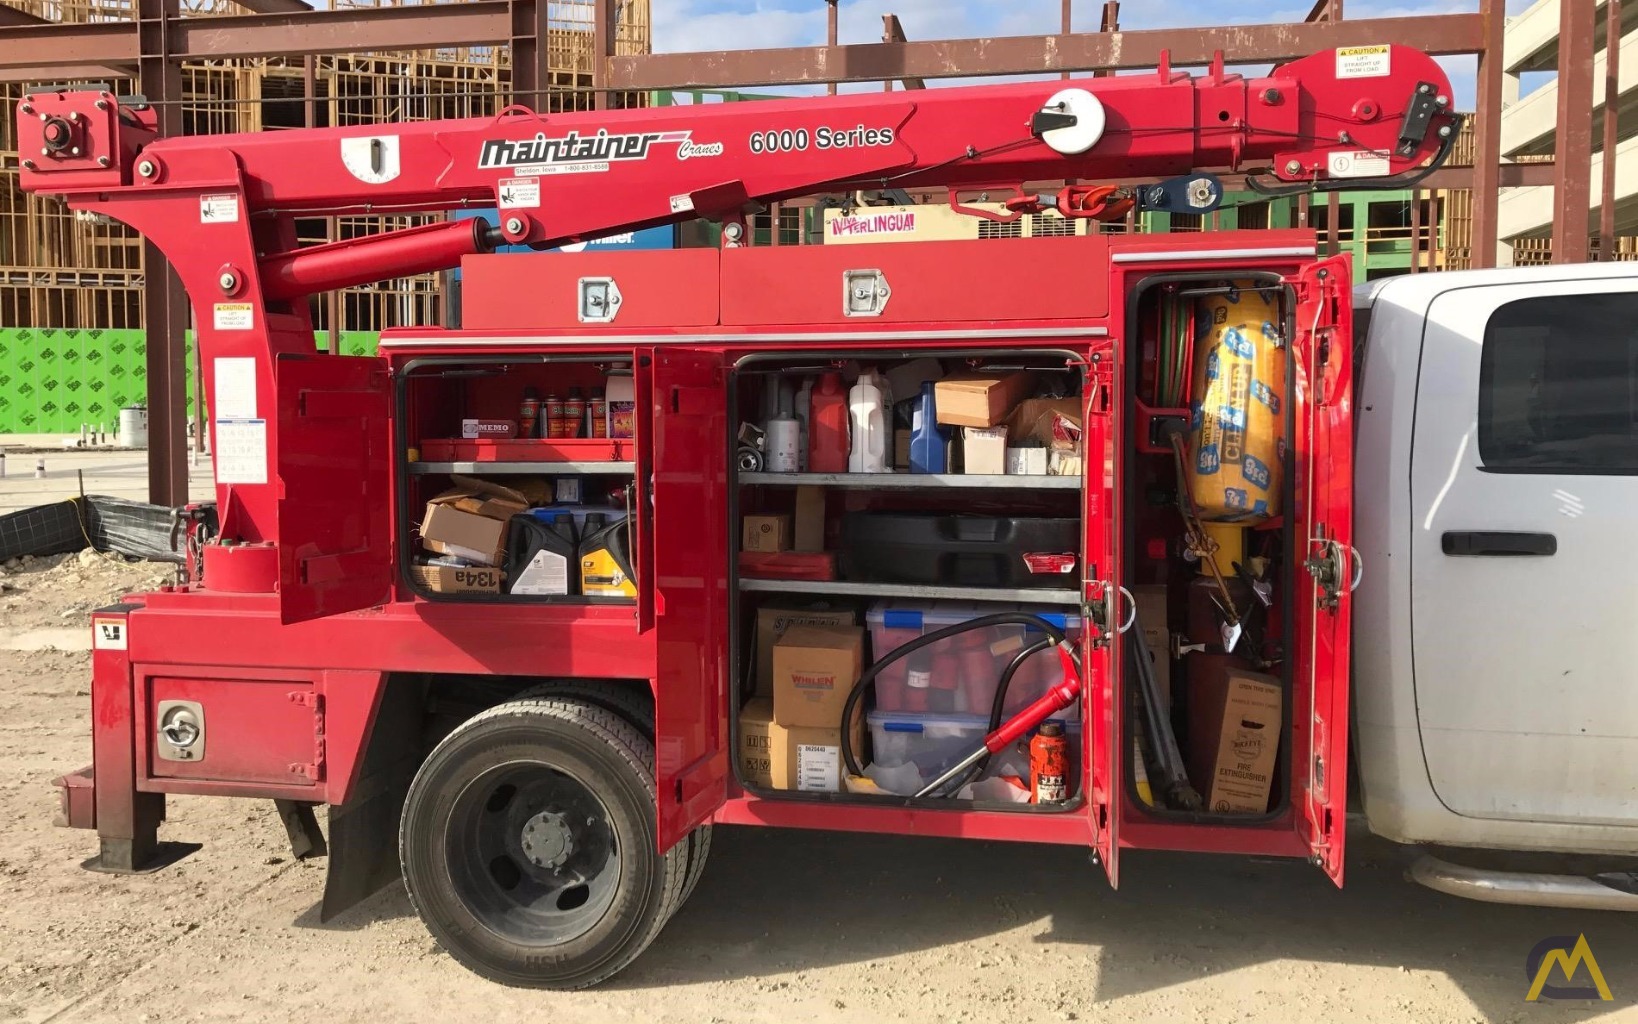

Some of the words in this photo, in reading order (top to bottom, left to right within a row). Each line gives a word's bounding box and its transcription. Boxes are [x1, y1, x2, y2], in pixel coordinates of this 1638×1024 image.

[750, 131, 807, 153] 6000
[816, 125, 894, 149] Series
[678, 139, 722, 163] Cranes
[479, 424, 508, 432] MEMO
[456, 571, 497, 587] 134a
[1237, 762, 1251, 772] FIRE
[1219, 767, 1267, 784] EXTINGUISHER
